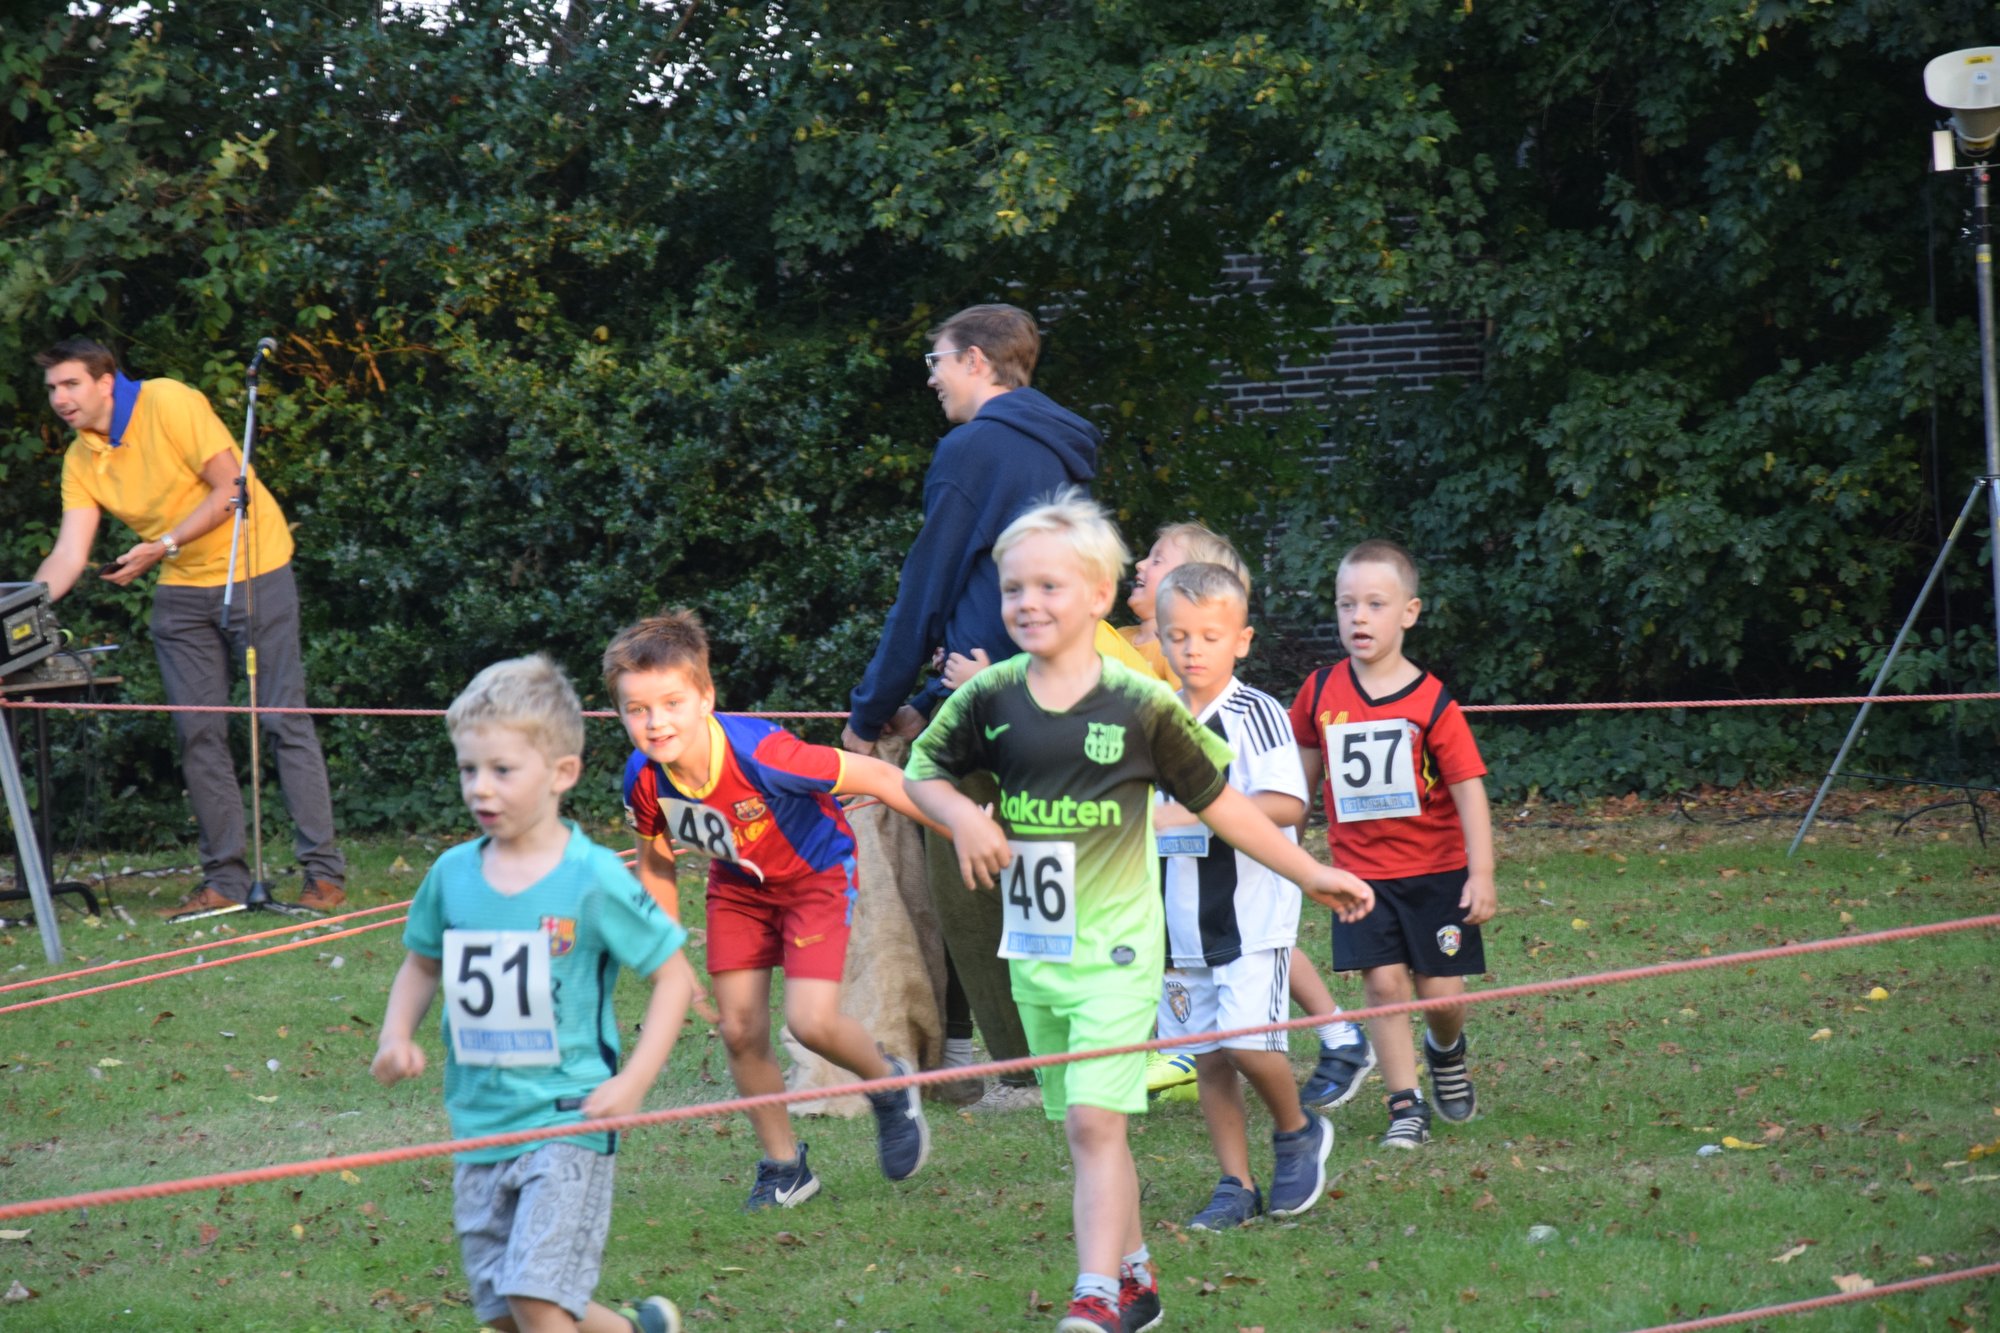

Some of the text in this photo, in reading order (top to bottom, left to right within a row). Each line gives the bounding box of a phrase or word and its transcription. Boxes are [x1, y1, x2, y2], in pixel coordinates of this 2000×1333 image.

[1341, 729, 1402, 788] 57
[678, 806, 732, 862] 48
[1008, 854, 1067, 922] 46
[458, 944, 532, 1018] 51
